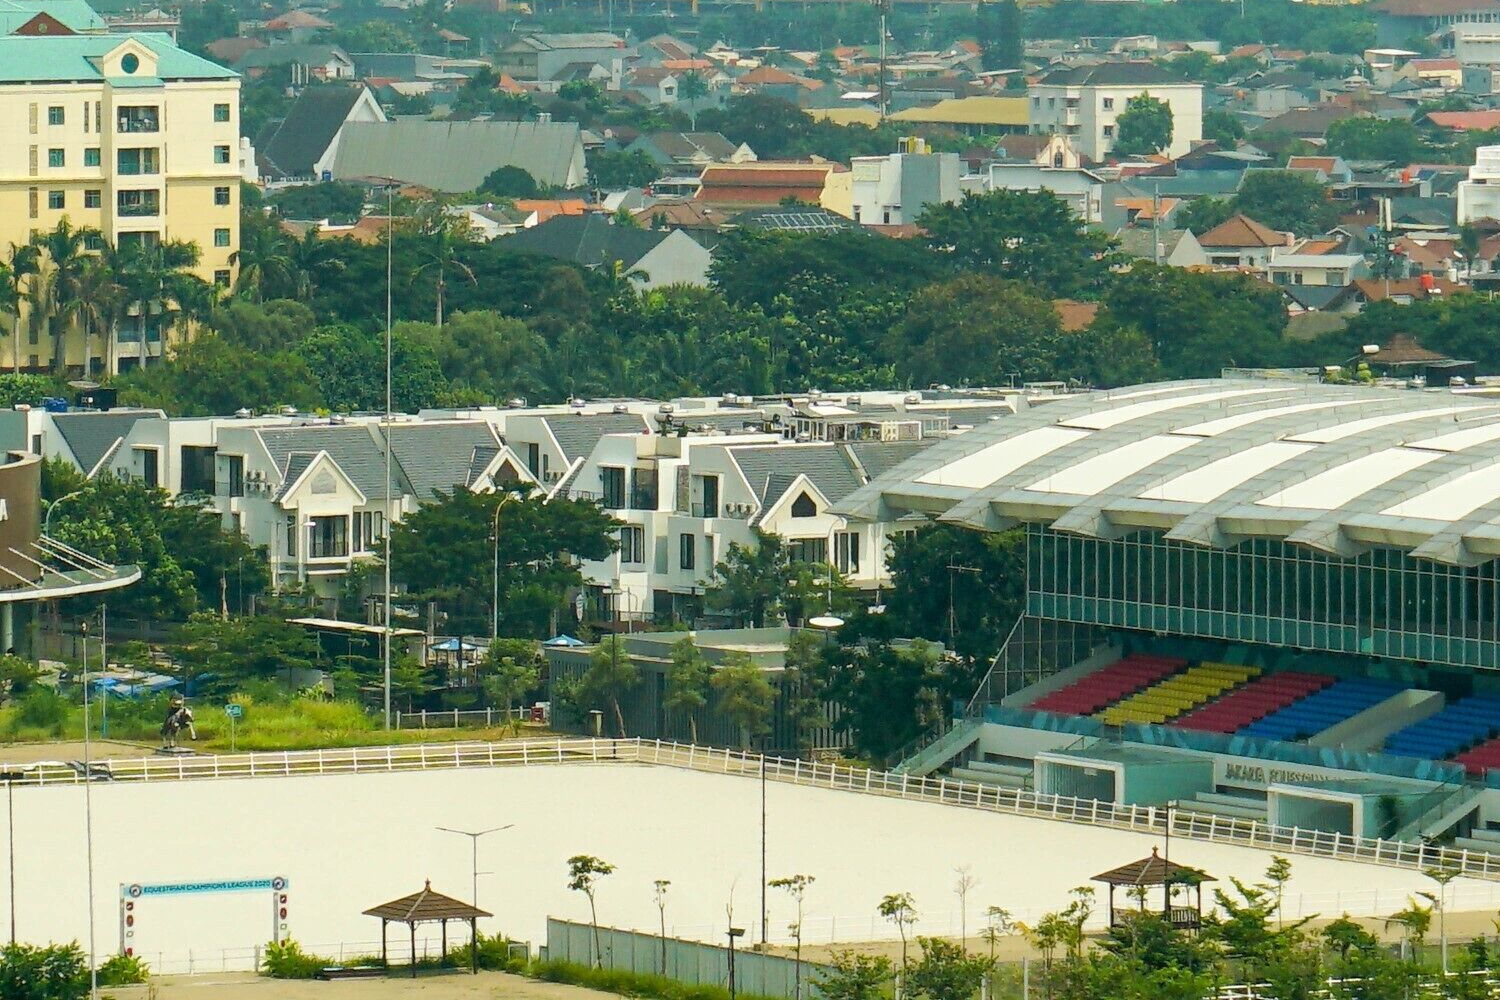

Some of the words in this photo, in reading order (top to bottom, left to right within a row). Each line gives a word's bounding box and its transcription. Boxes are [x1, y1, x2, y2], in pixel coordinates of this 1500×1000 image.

[144, 884, 185, 893] EQUESTRIAN
[187, 882, 226, 890] CHAMPIONS
[227, 880, 253, 889] LEAGUE
